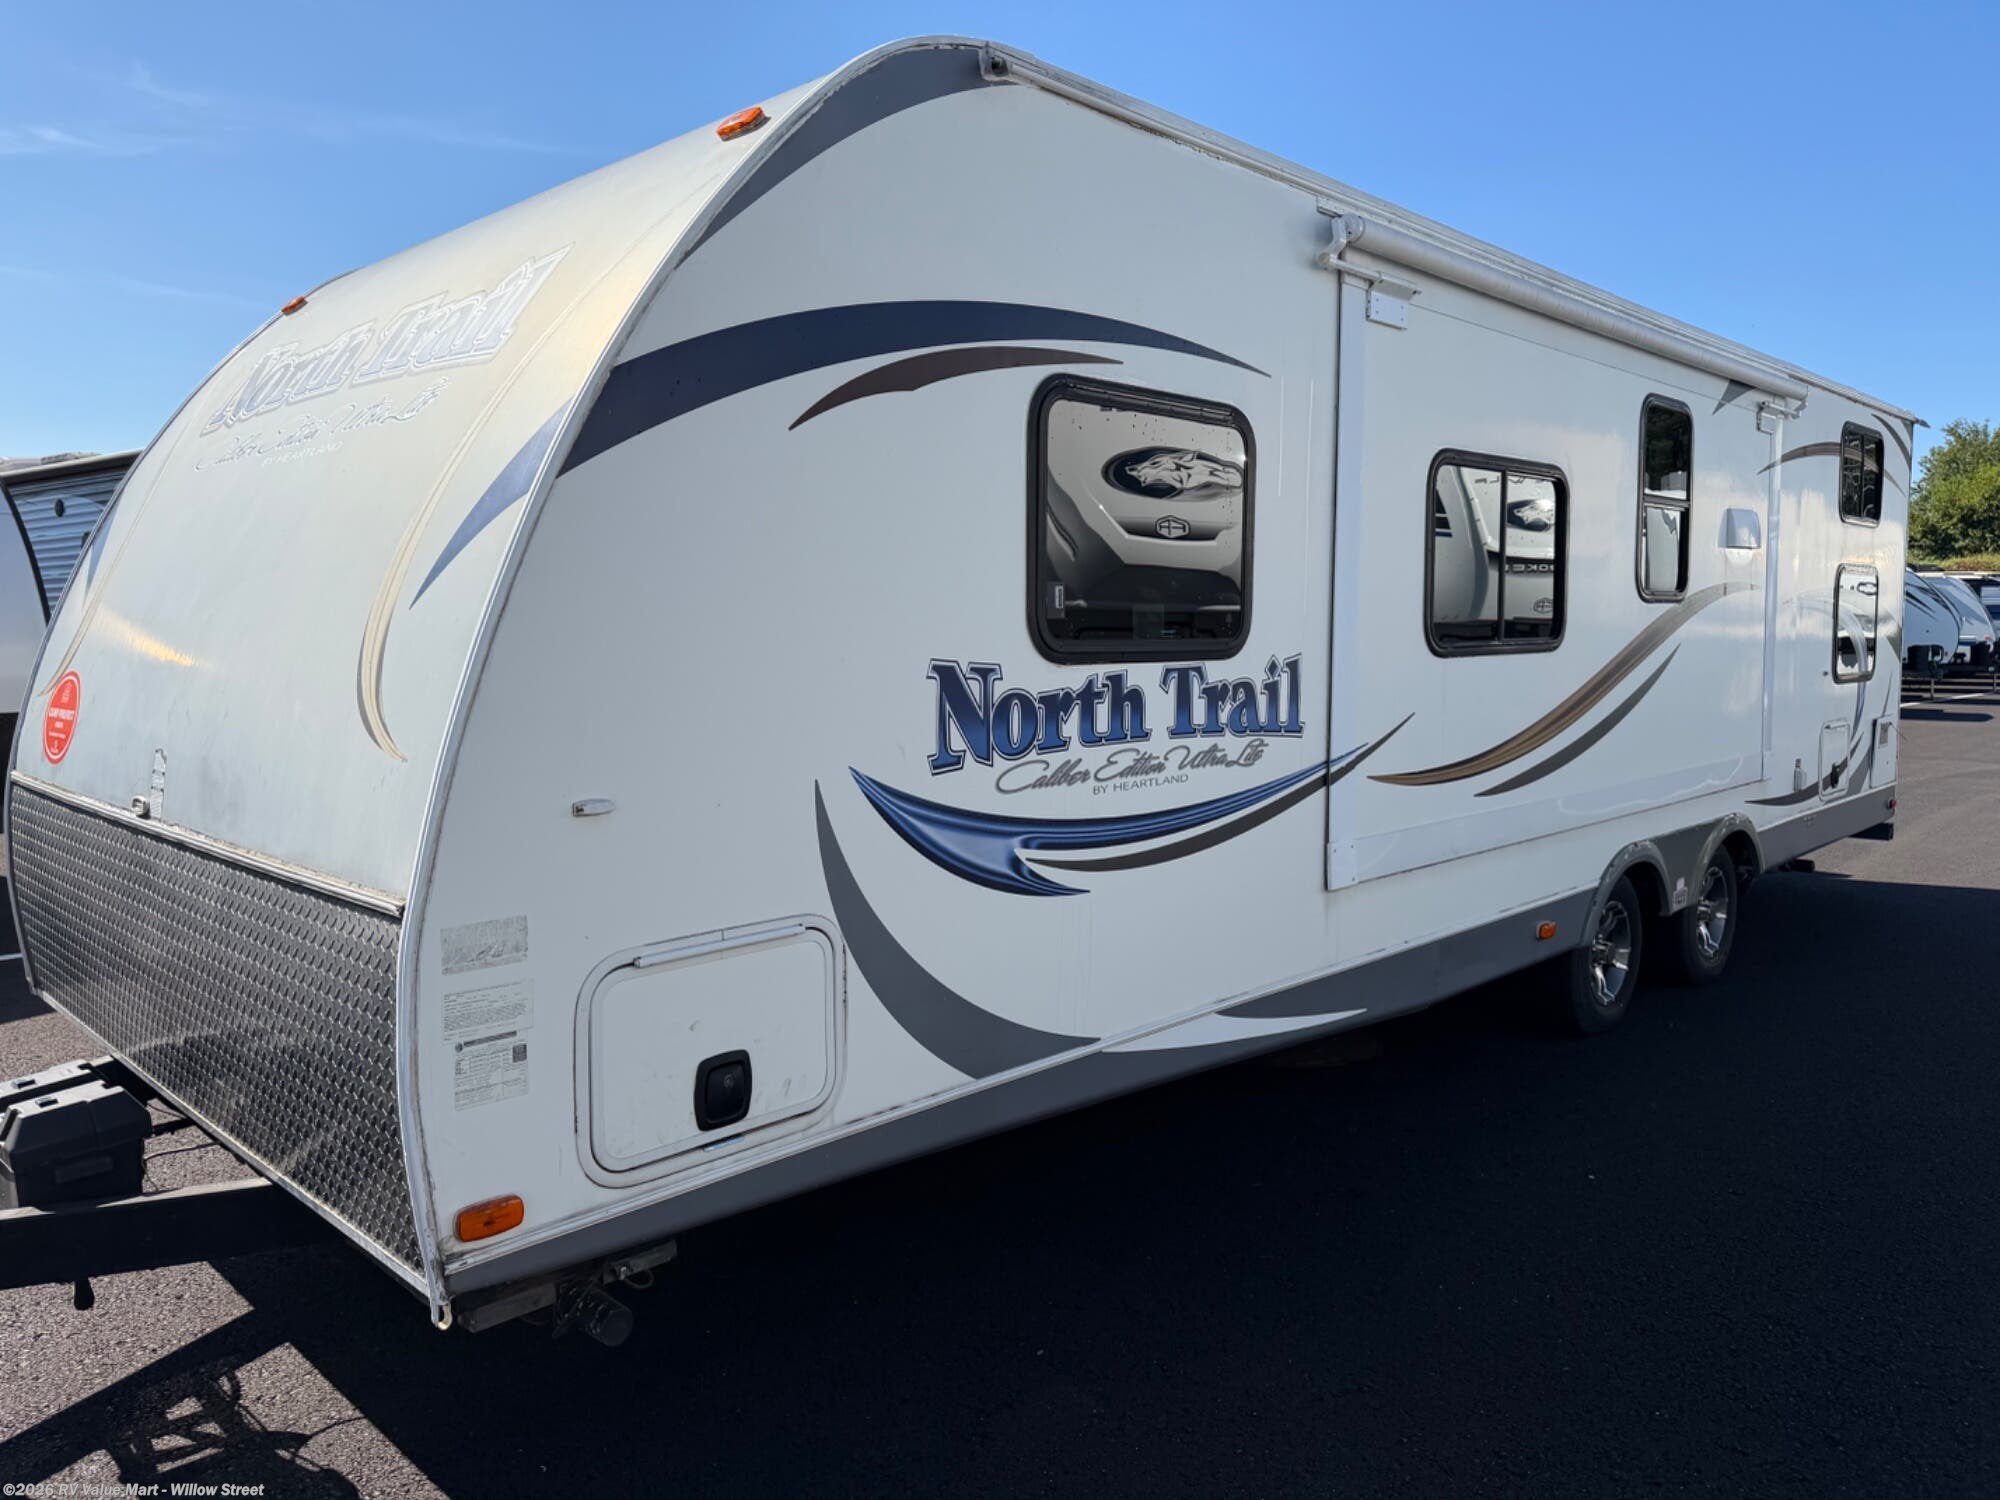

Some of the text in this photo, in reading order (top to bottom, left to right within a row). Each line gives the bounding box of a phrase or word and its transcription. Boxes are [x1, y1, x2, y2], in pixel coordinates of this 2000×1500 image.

[926, 652, 1306, 776] North Trail
[995, 758, 1092, 795] Caliber
[1093, 748, 1168, 783] Edition
[1092, 773, 1189, 796] BY HEARTLAND
